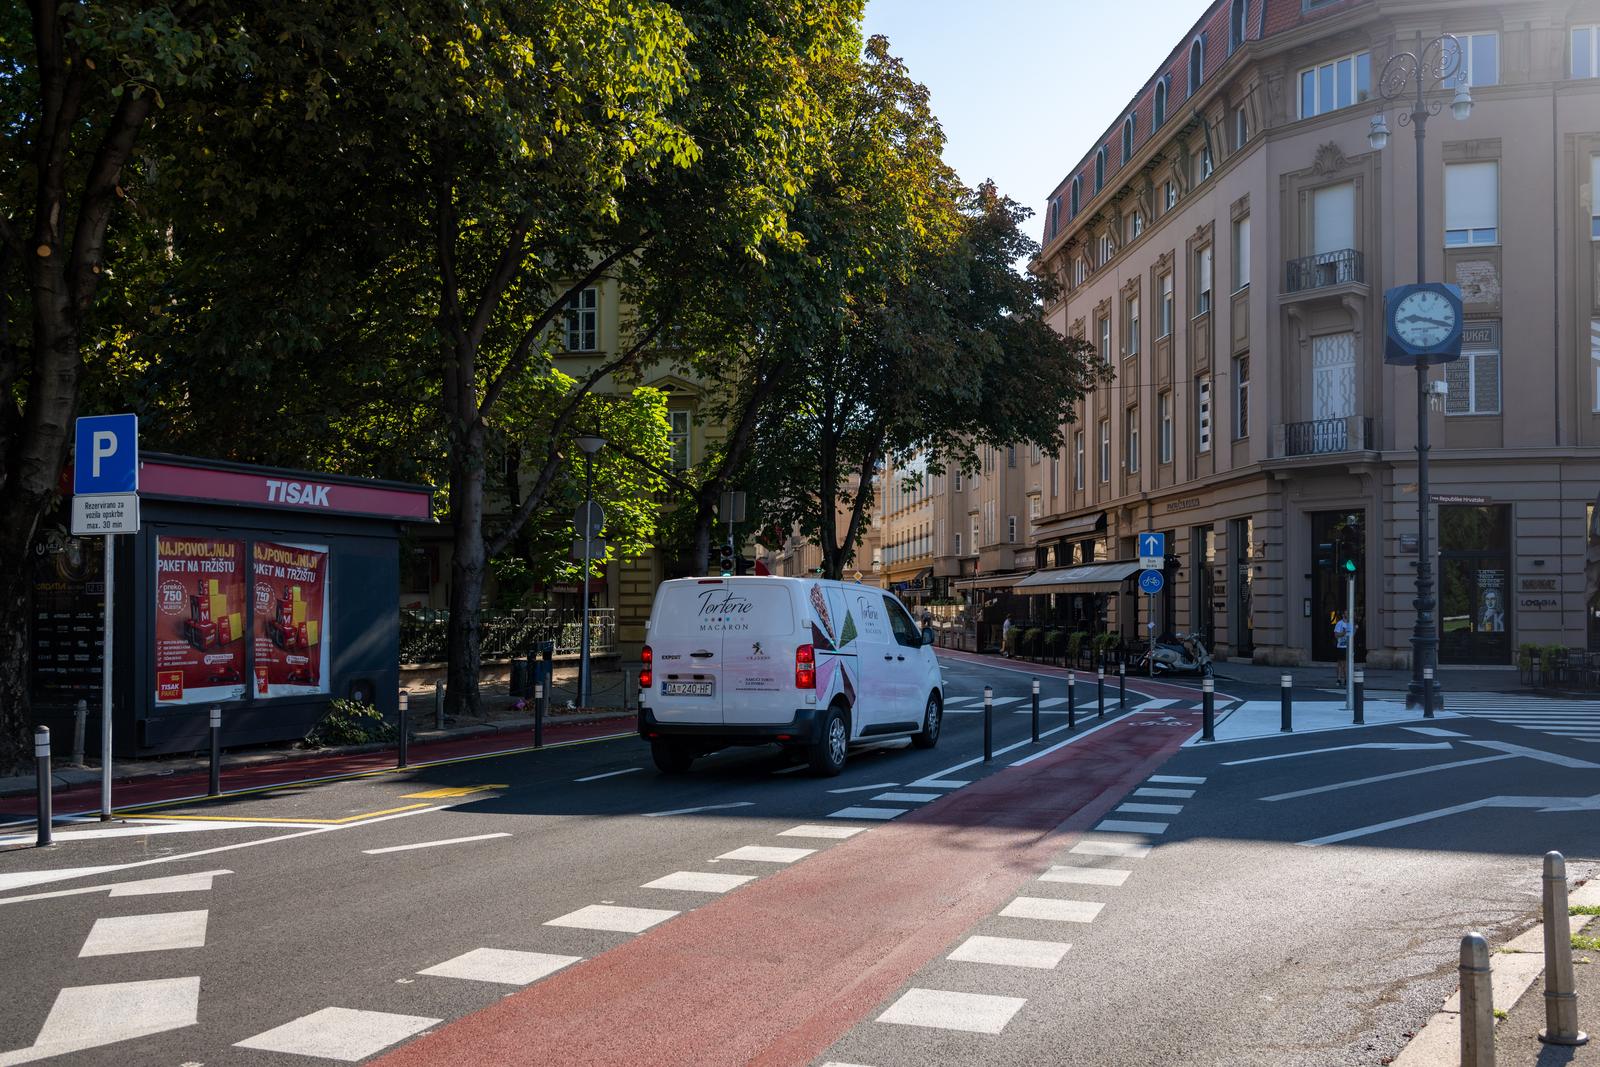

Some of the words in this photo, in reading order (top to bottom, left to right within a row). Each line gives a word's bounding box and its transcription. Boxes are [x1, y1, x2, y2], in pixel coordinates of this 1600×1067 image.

[93, 431, 117, 477] P
[266, 480, 332, 506] TISAK
[84, 502, 116, 511] Rezervirano
[102, 511, 123, 520] opskrbe
[102, 521, 111, 529] 30
[158, 541, 235, 557] NAJPOVOLJNIJI
[157, 559, 185, 572] PAKET
[187, 560, 199, 572] NA
[200, 557, 235, 573] TRŽIŠTU
[275, 566, 285, 579] NA
[286, 566, 316, 583] TRŽIŠTU
[163, 590, 182, 601] 750
[697, 588, 753, 617] Torterie
[699, 624, 749, 632] MACARON
